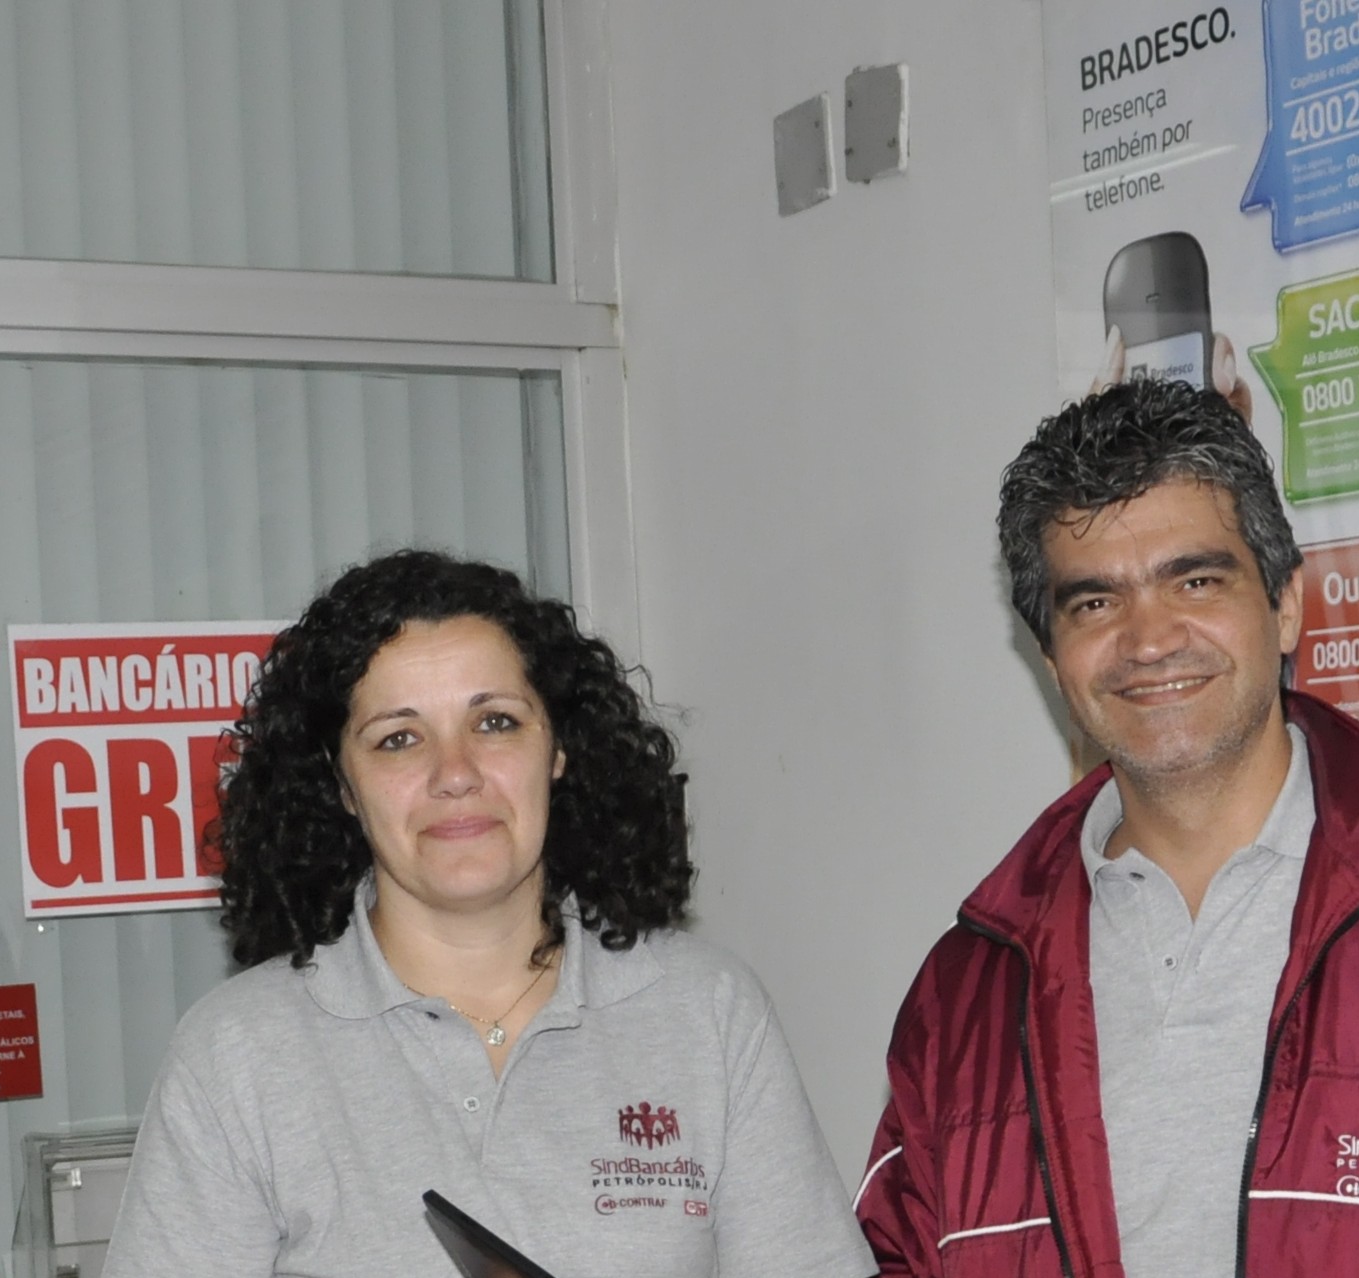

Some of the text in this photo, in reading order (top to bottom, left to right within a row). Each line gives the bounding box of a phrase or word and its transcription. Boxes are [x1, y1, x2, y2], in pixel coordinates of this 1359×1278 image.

[1080, 7, 1235, 91] BRADESCO.
[1291, 70, 1327, 89] Capitais
[1329, 68, 1335, 77] e
[1082, 89, 1167, 134] Presença
[1083, 119, 1193, 172] também por
[1085, 172, 1164, 212] telefone.
[1151, 363, 1193, 379] Bradesco
[1318, 346, 1359, 364] Bradesco
[1303, 377, 1354, 413] 0800
[23, 644, 263, 714] BANCÁRIO
[590, 1156, 705, 1178] SindBancários
